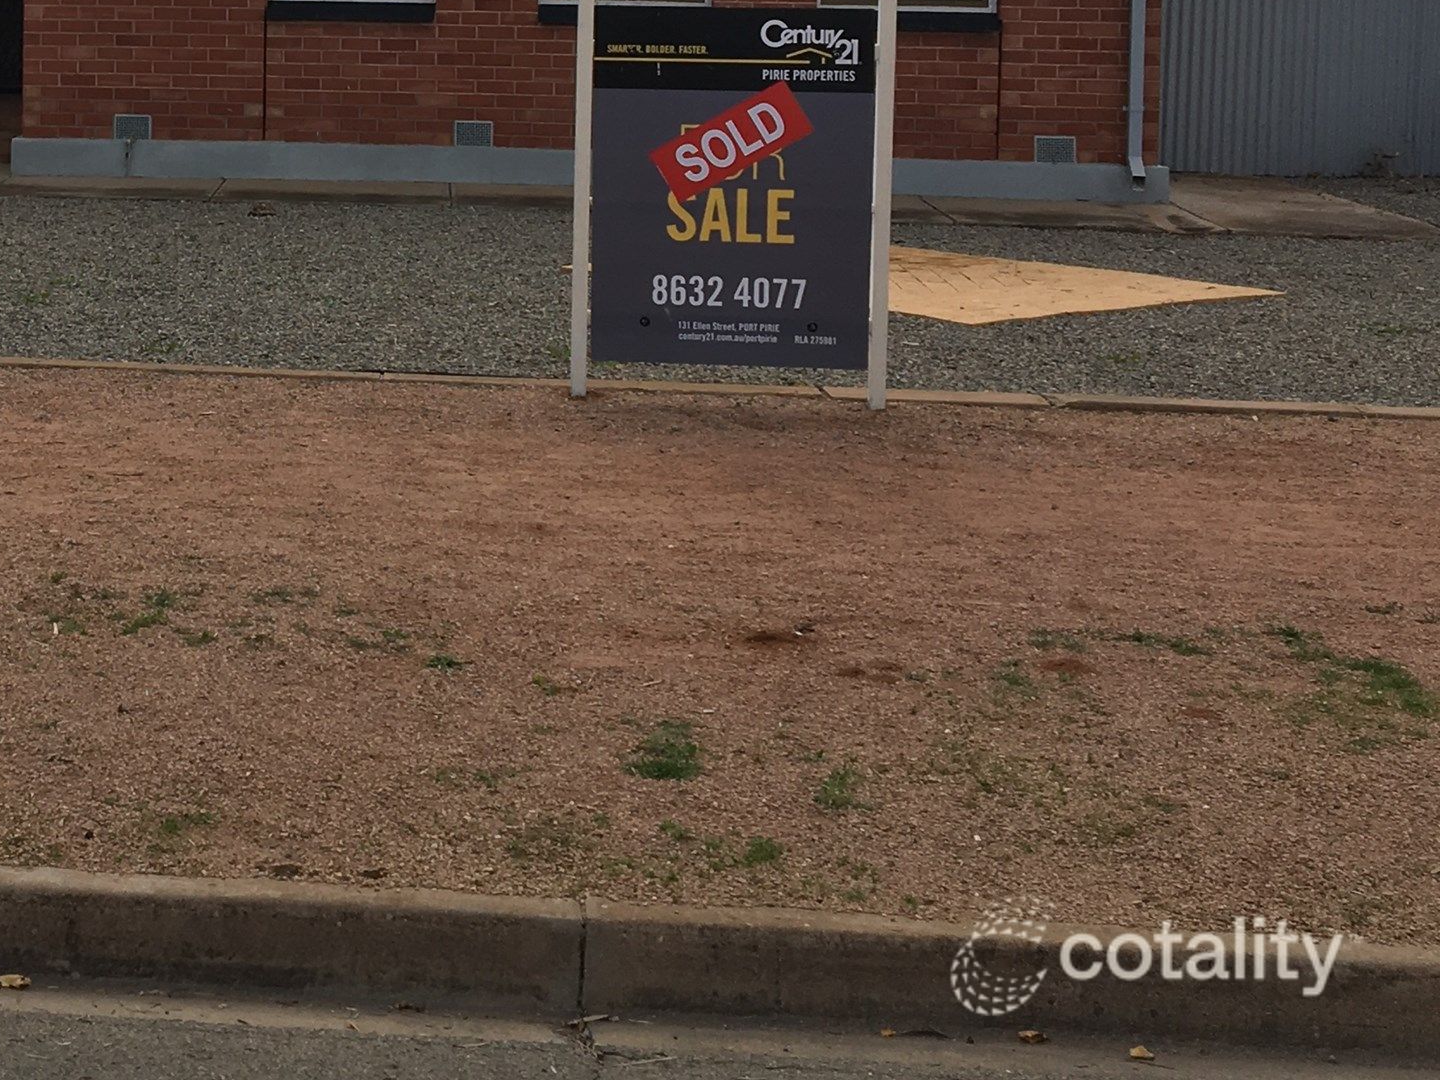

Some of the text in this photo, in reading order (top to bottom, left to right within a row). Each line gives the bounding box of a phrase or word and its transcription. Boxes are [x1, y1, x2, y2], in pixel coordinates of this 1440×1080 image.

[760, 19, 844, 49] Century
[679, 45, 709, 55] FASTER.
[834, 38, 859, 65] 21
[762, 68, 856, 82] PIRIE PROPERTIES
[675, 102, 785, 182] SOLD
[666, 187, 795, 244] SALE
[652, 274, 807, 309] 8632 4077
[678, 321, 690, 330] 131
[692, 321, 710, 331] Ellen
[738, 322, 758, 332] PORT
[760, 323, 780, 333] PIRIE
[678, 332, 778, 344] century21.com.au/portpirie
[794, 335, 808, 344] RLA
